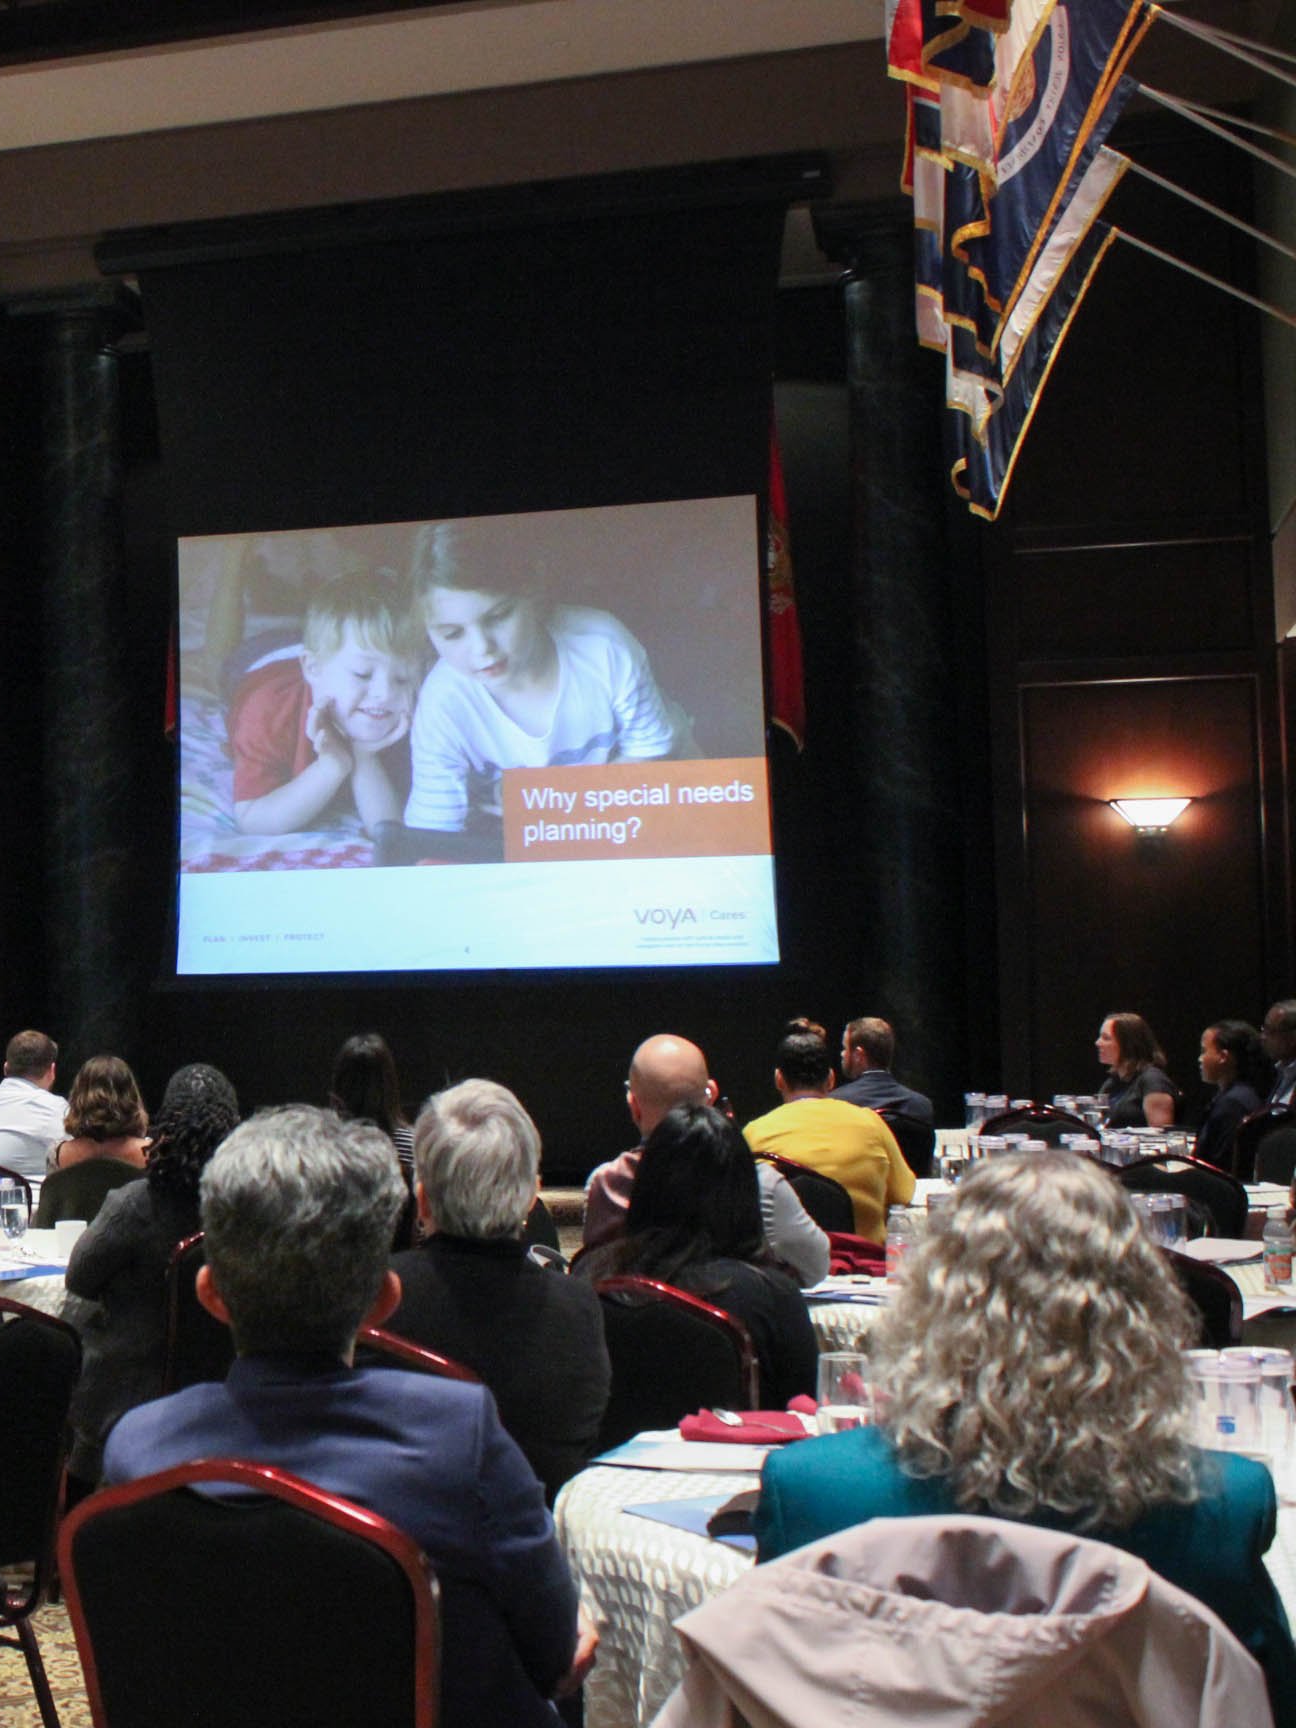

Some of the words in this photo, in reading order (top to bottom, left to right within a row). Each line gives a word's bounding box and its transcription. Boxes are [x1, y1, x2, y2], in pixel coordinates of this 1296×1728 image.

[521, 787, 577, 814] Why
[584, 783, 669, 812] special
[678, 780, 754, 804] needs
[523, 816, 642, 847] planning?
